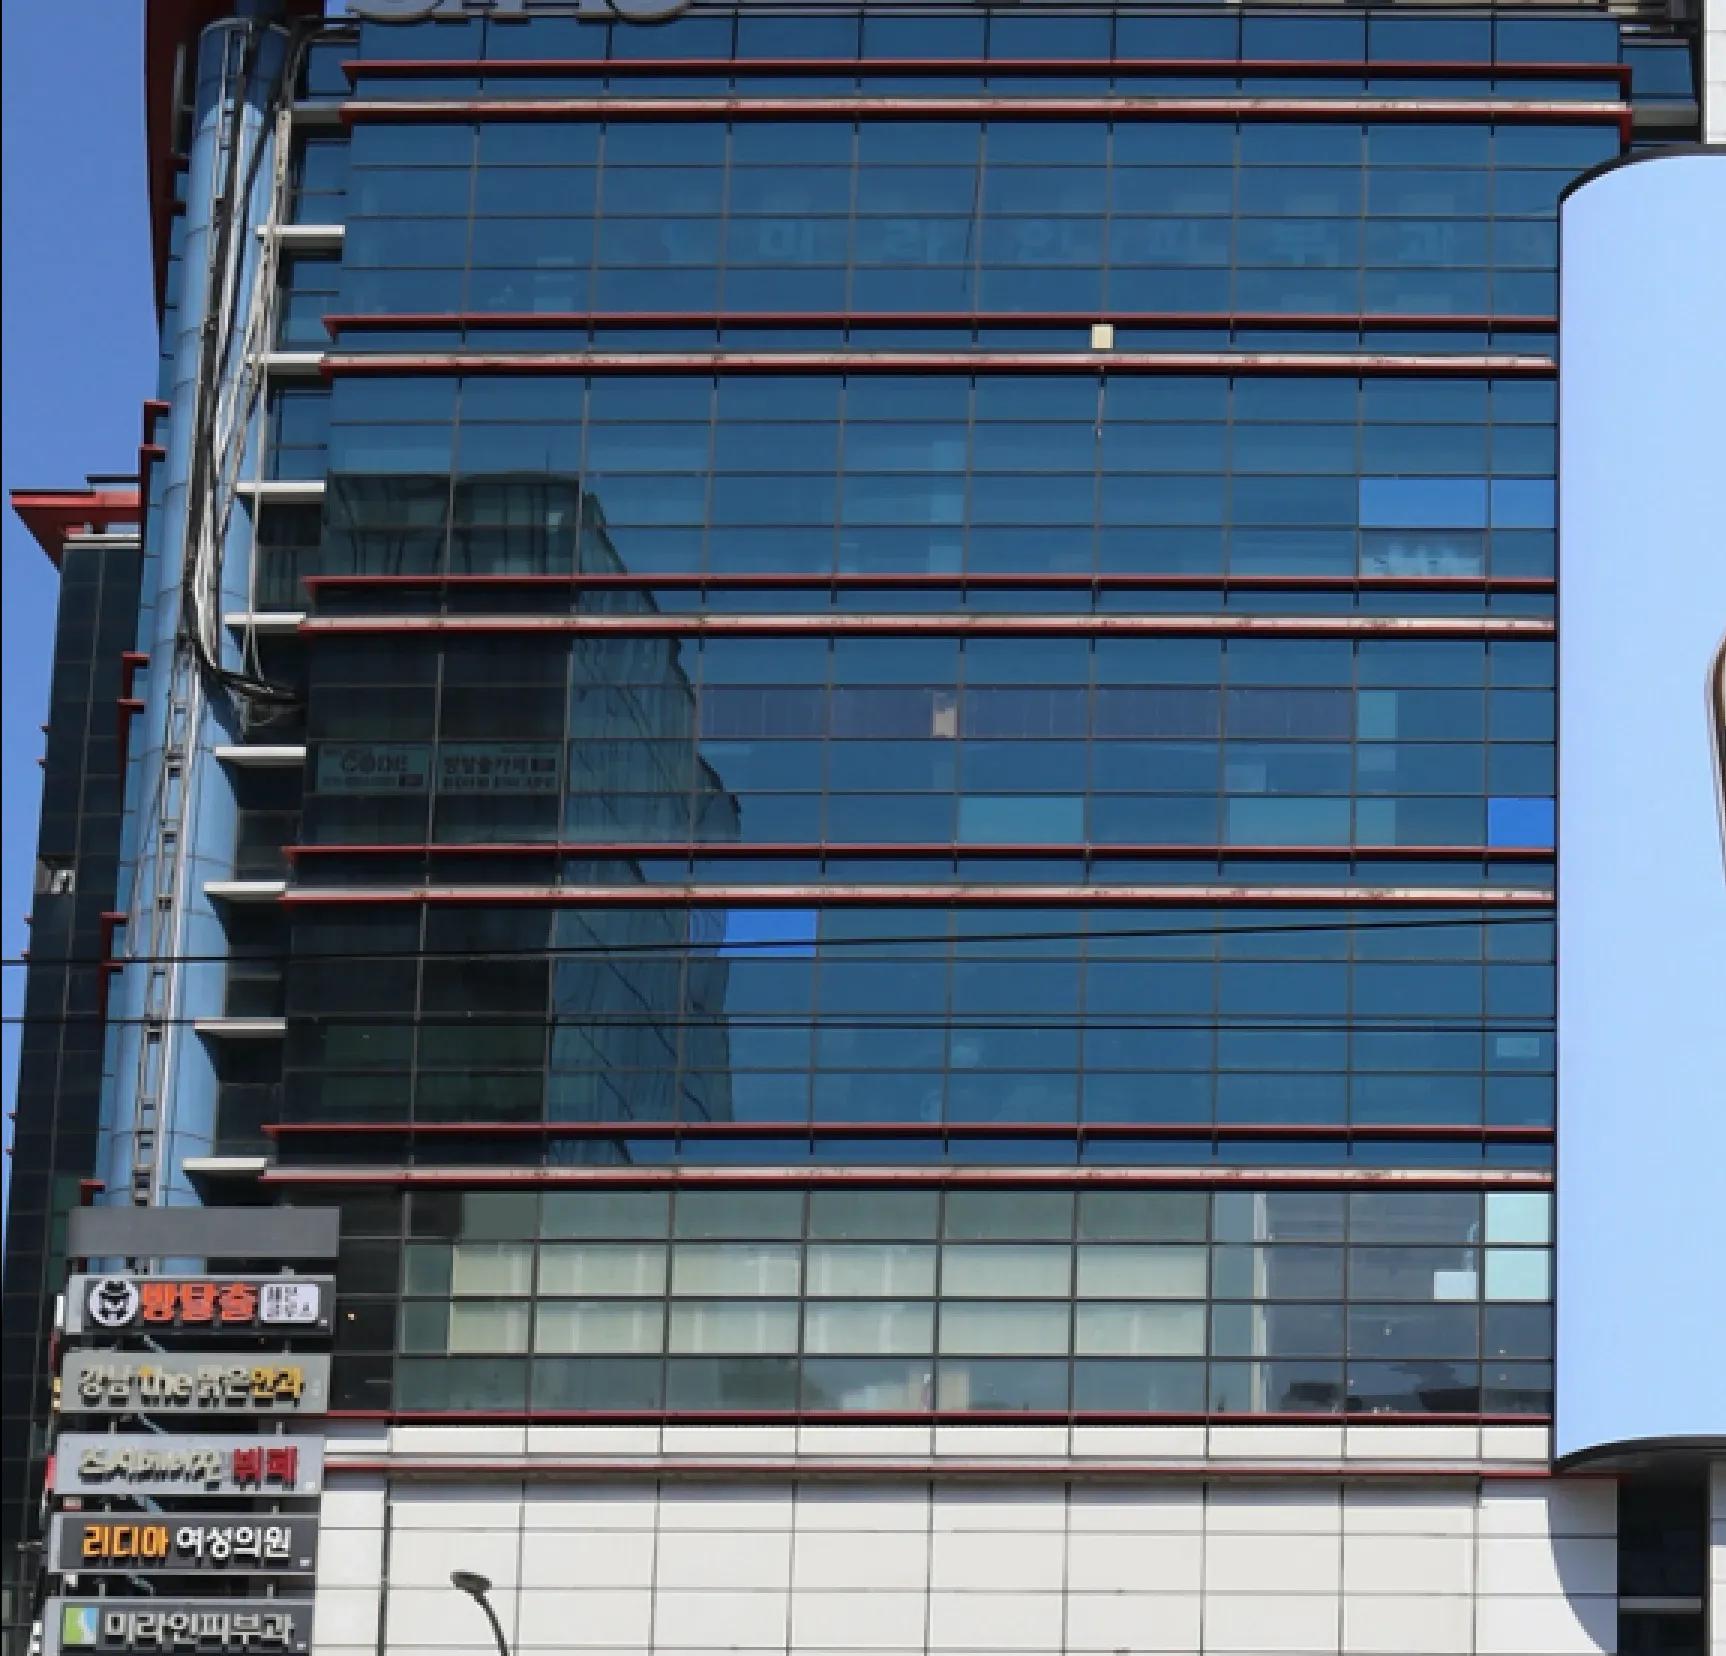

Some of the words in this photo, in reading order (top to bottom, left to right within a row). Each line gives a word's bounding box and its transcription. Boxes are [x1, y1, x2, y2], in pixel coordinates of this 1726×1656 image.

[81, 1526, 169, 1558] 리디아
[176, 1526, 292, 1559] 여성의원
[105, 1612, 296, 1645] 미라인피부과
